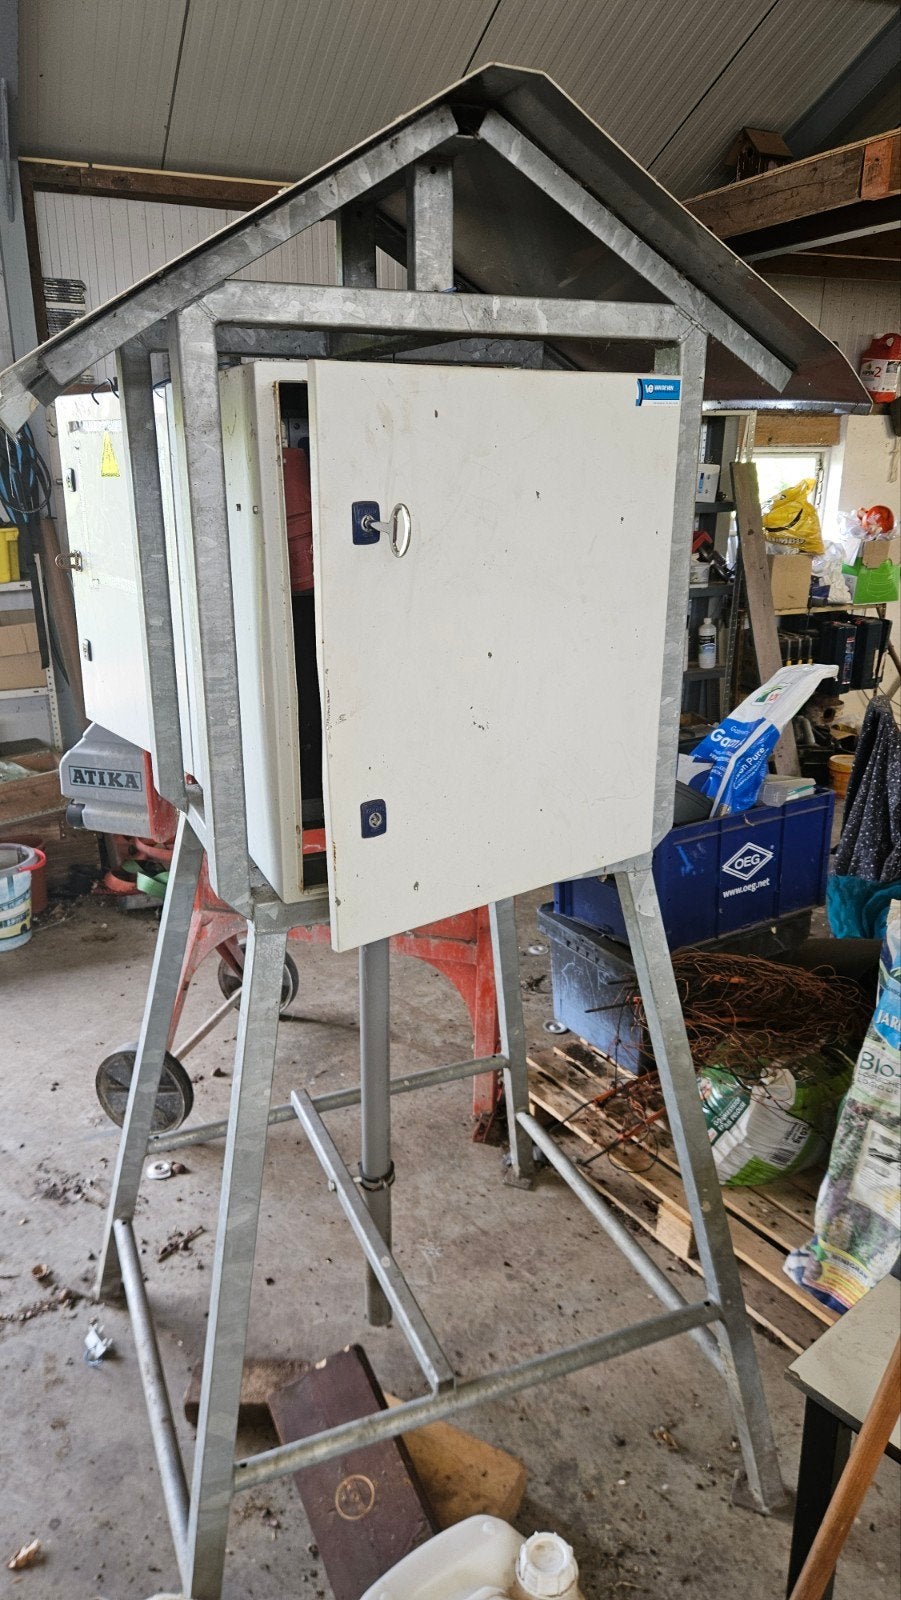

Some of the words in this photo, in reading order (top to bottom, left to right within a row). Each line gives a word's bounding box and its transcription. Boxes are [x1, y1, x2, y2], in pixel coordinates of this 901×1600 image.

[746, 747, 765, 766] Pure
[72, 768, 140, 789] ATIKA
[734, 853, 761, 870] OEG
[722, 877, 771, 899] www.oeg.net
